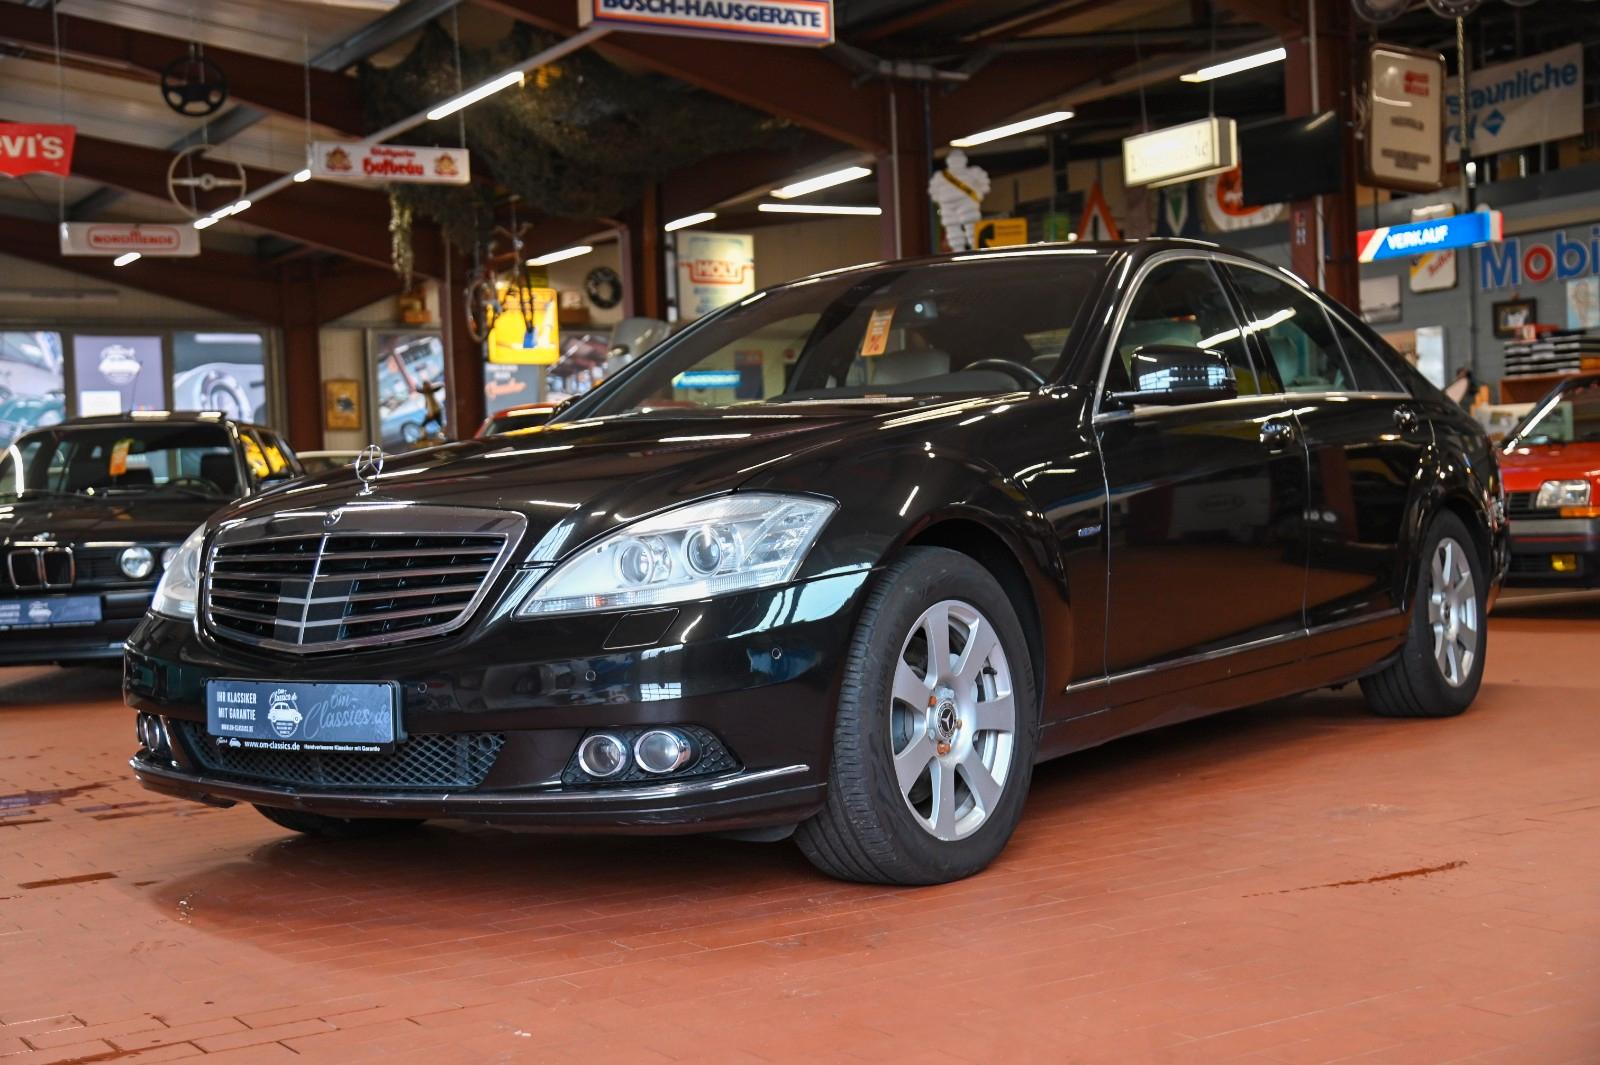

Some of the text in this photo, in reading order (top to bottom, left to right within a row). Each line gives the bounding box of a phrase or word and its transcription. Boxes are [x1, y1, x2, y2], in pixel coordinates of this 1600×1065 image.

[1387, 225, 1448, 250] VERKAUF
[1479, 223, 1600, 290] Mobi
[216, 691, 257, 704] IHR KLASSIKER
[218, 707, 256, 720] MIT GARANTIE
[244, 740, 301, 751] www.om-classics.de
